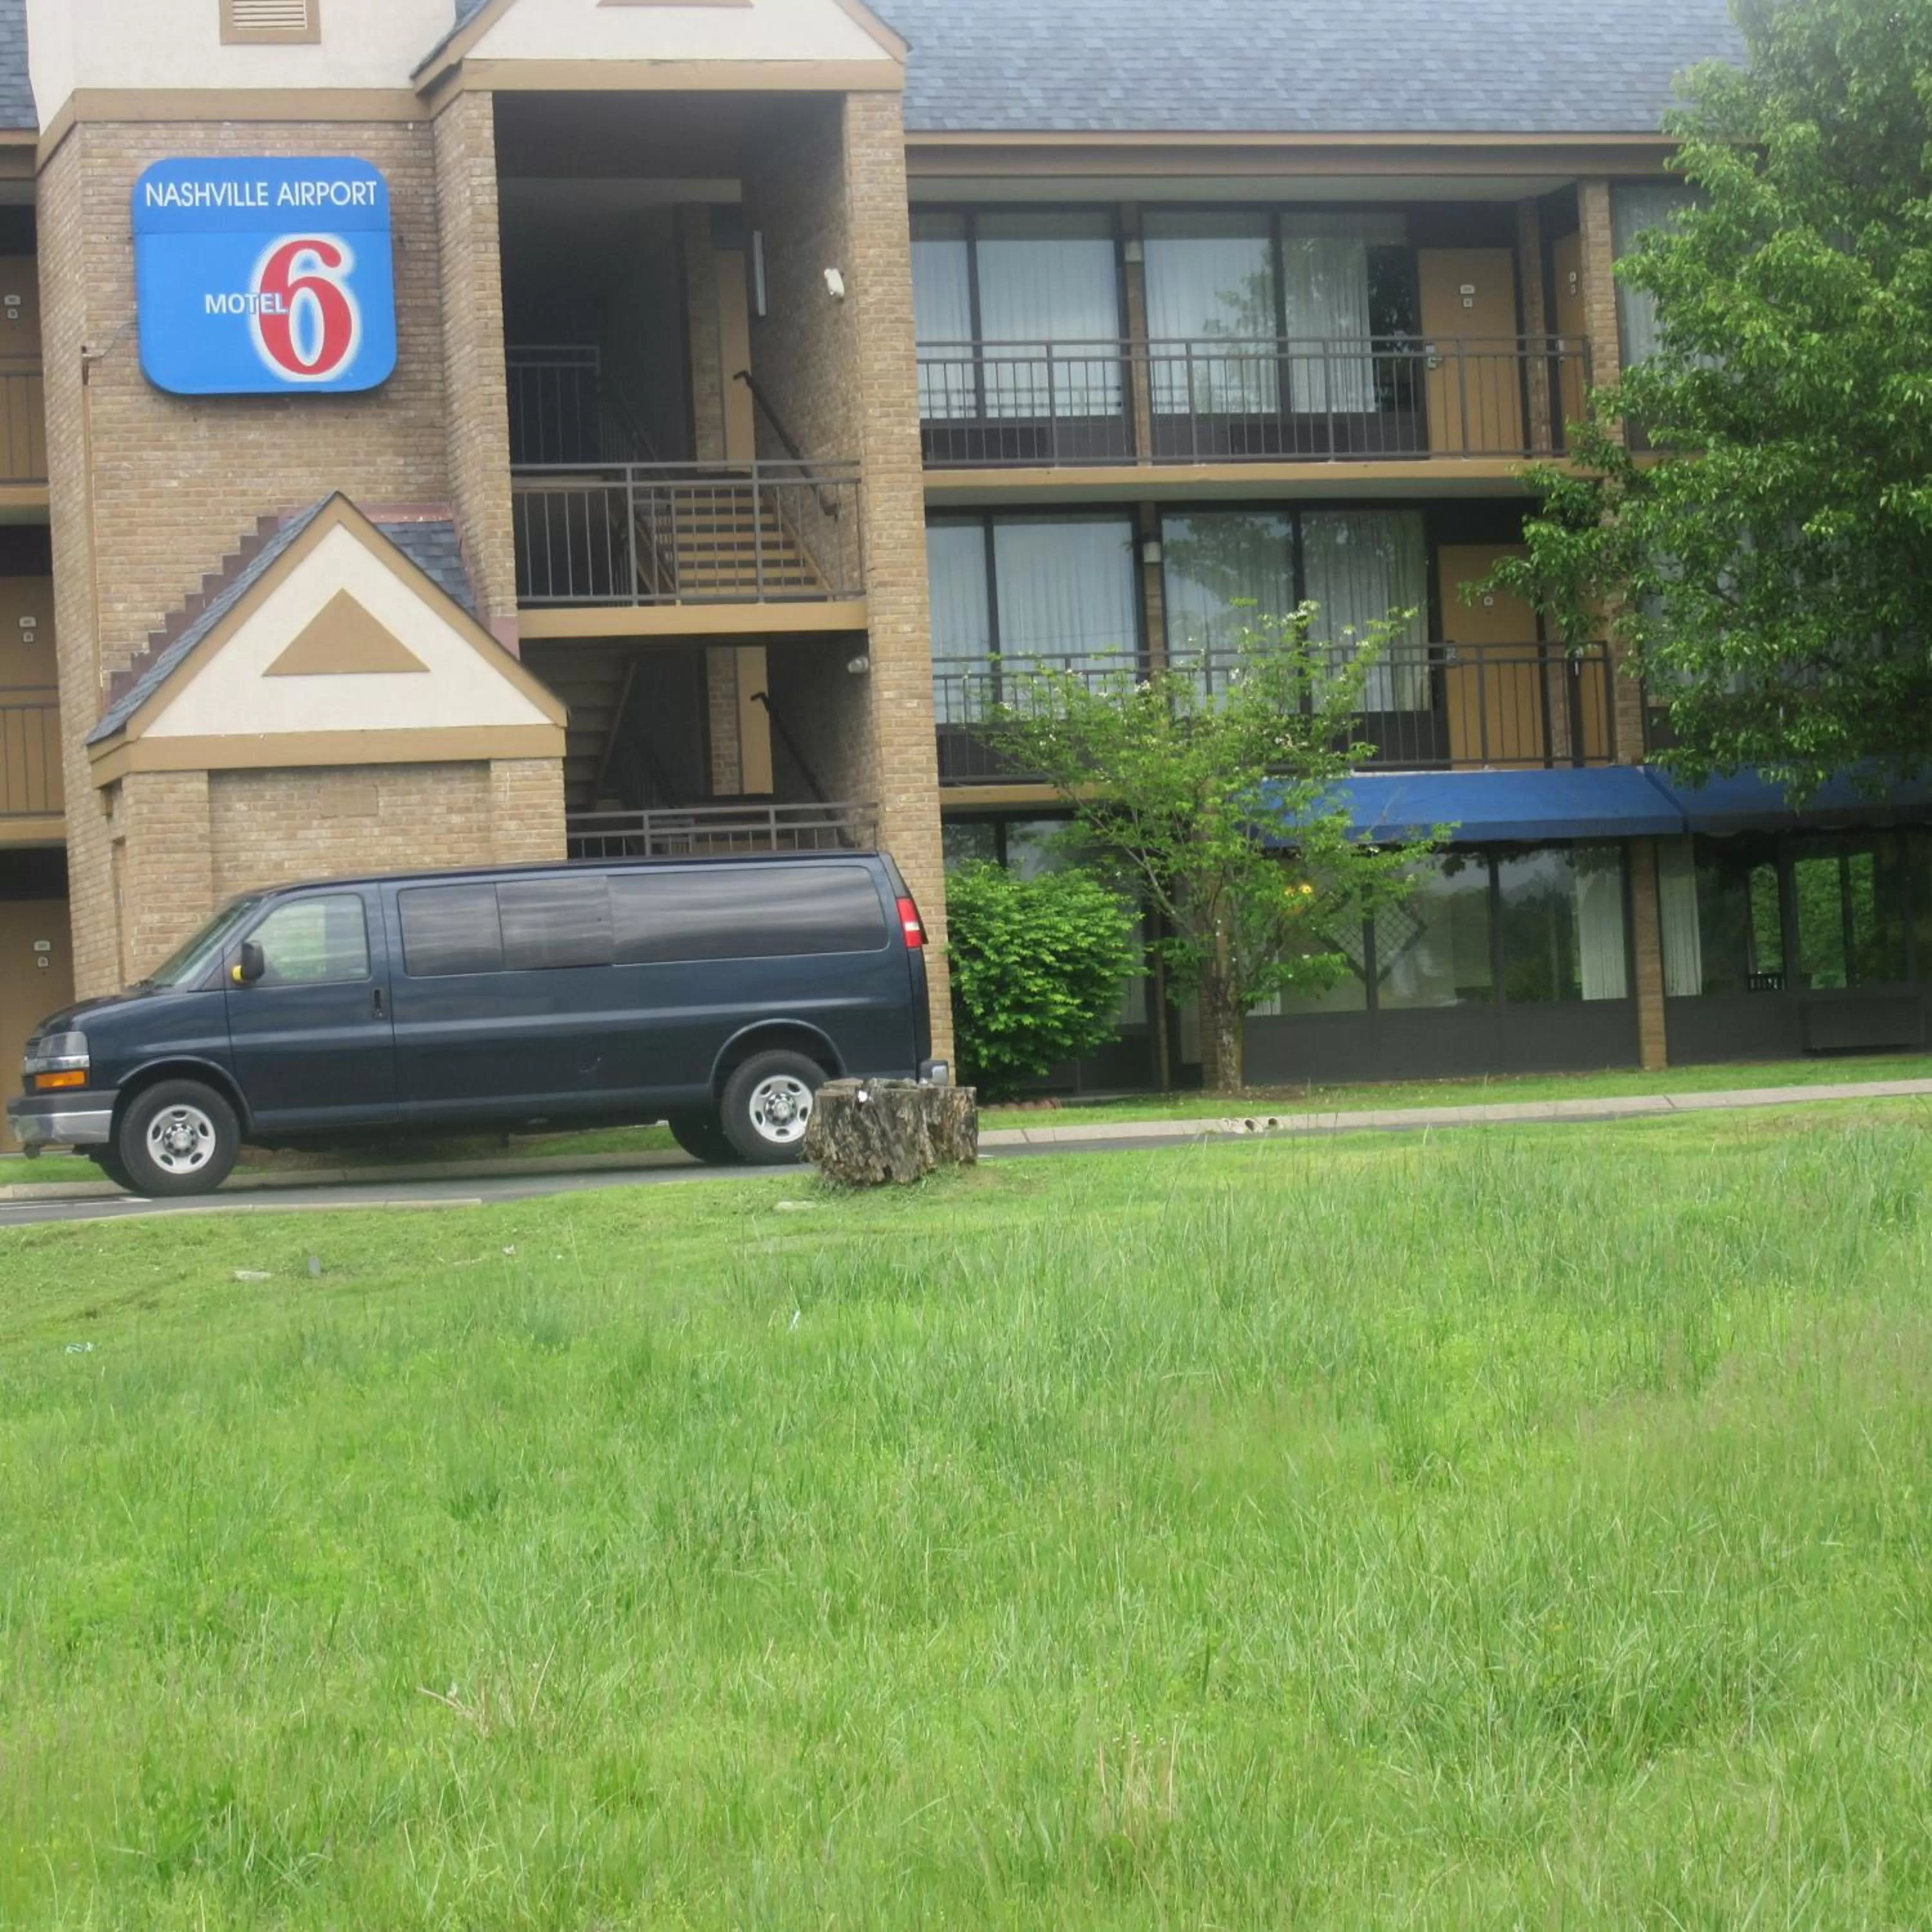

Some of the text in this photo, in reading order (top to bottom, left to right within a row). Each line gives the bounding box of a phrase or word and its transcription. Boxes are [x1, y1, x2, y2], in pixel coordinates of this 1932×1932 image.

[146, 181, 377, 207] NASHVILLE AIRPORT
[205, 234, 358, 380] MOTEL 6
